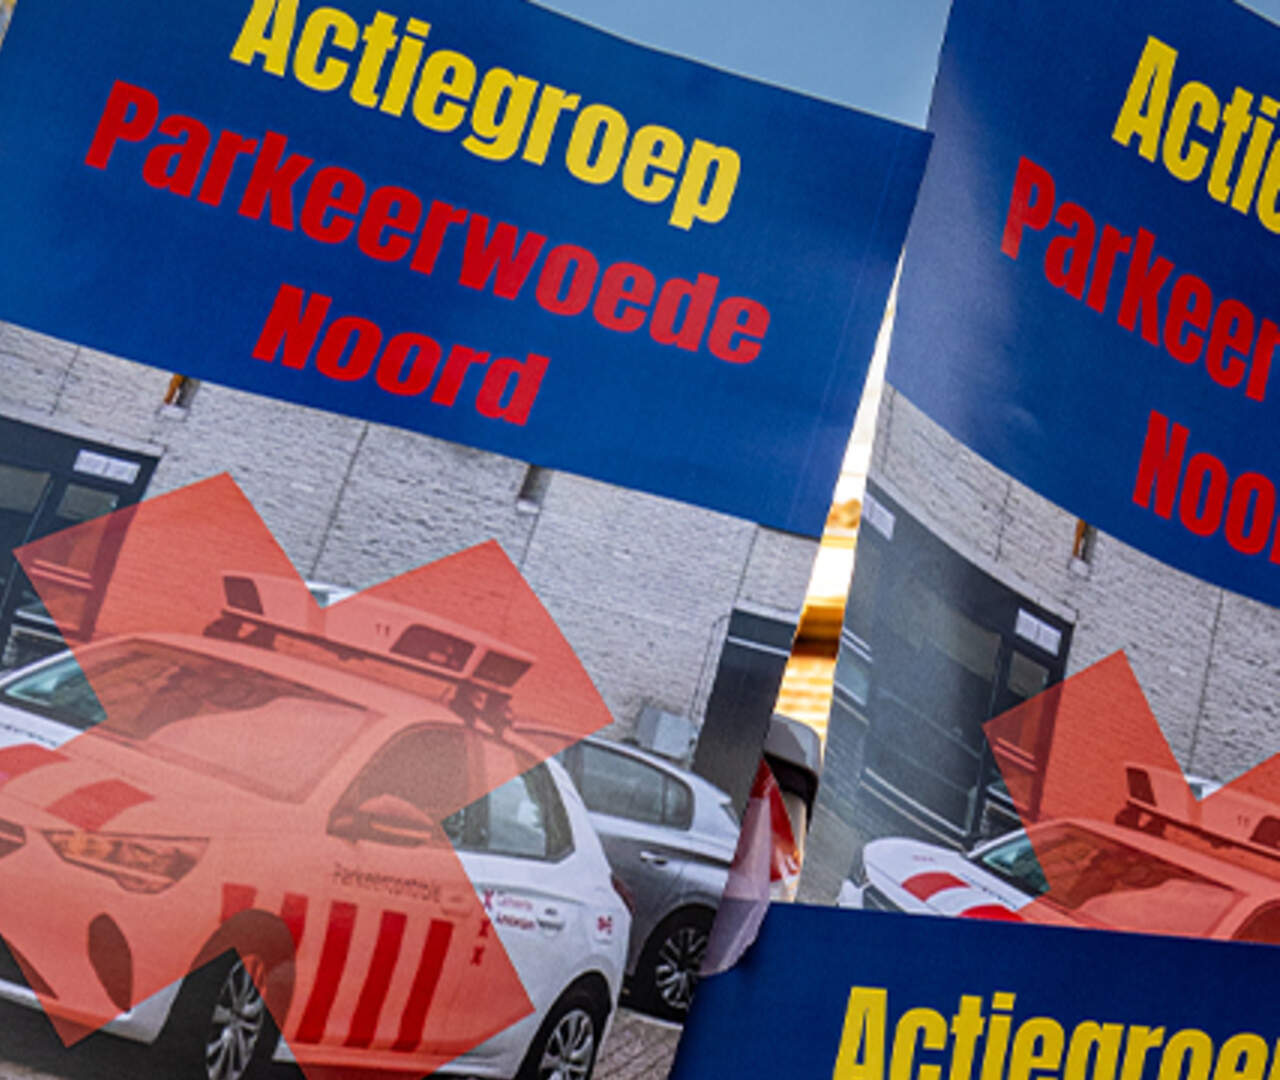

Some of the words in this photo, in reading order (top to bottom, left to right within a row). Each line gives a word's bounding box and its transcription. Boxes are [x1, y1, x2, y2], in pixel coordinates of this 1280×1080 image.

[229, 0, 740, 229] Actiegroep
[85, 80, 769, 364] Parkeerwoede
[253, 283, 551, 425] Noord
[1133, 410, 1280, 564] Noo
